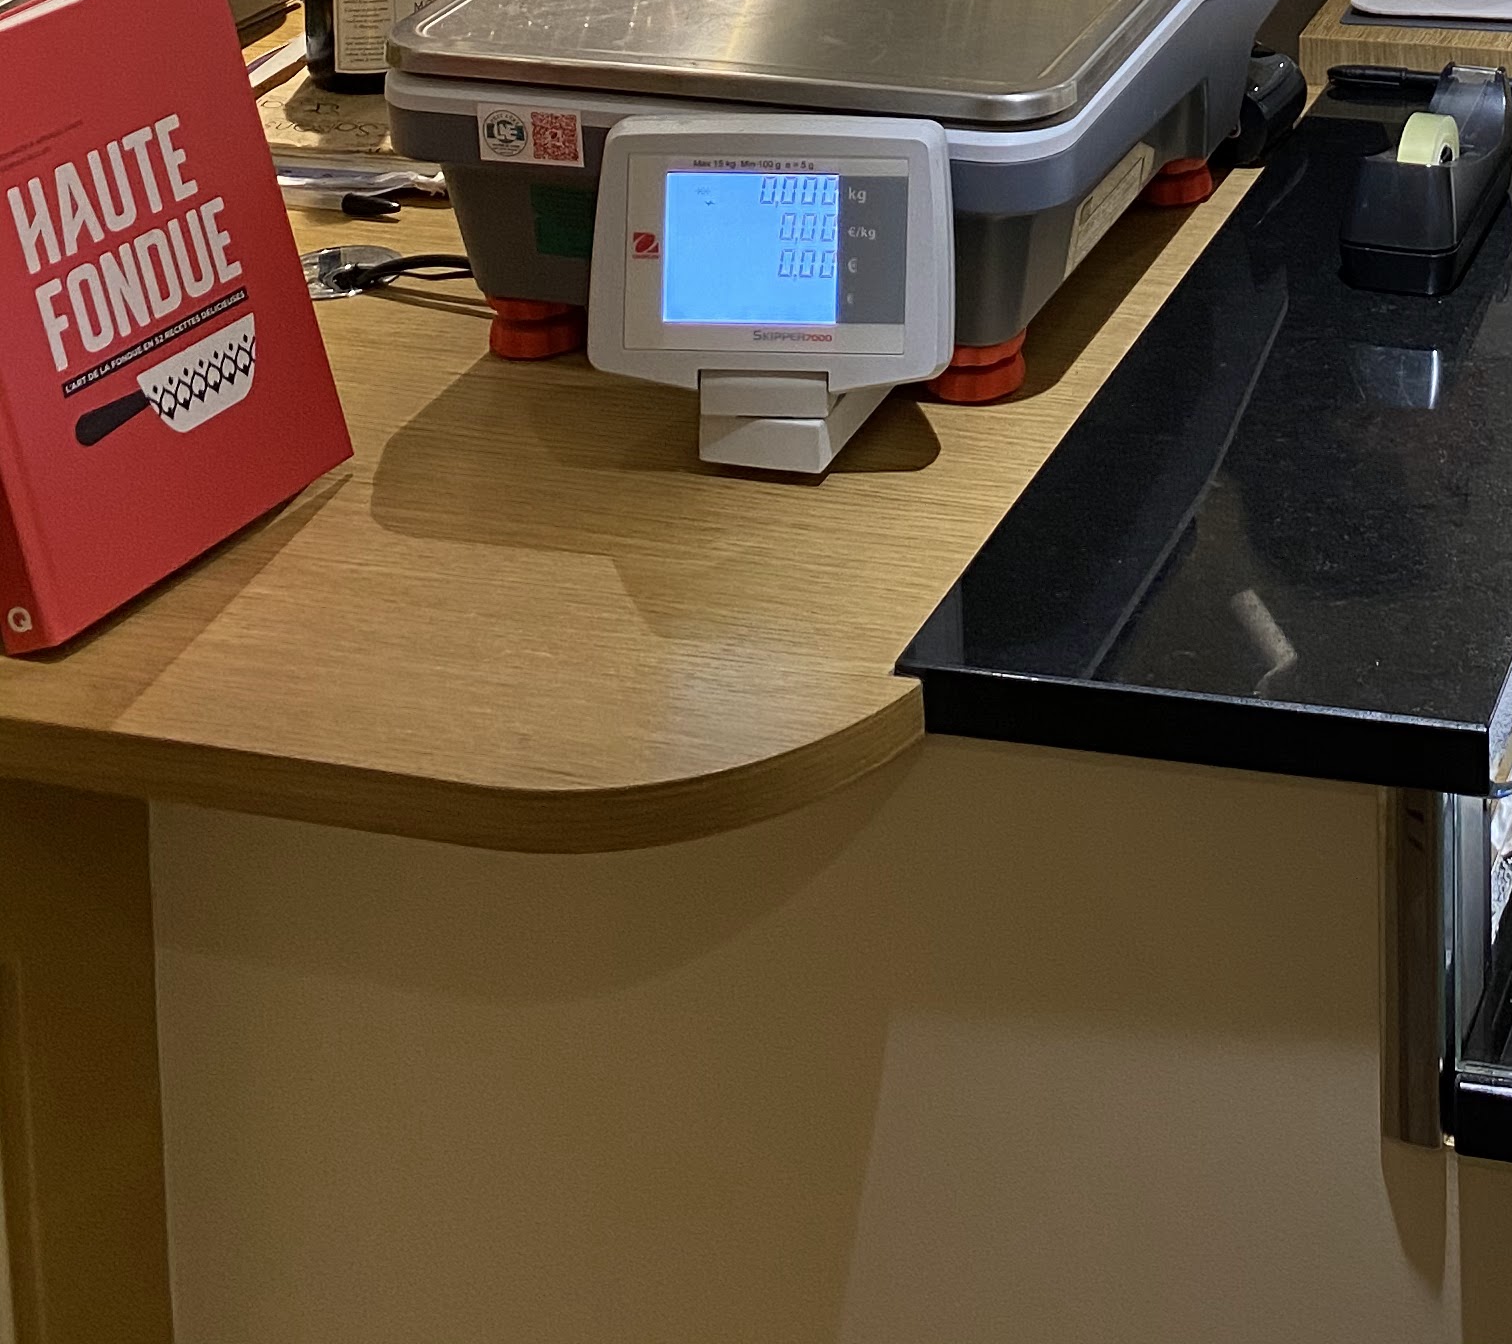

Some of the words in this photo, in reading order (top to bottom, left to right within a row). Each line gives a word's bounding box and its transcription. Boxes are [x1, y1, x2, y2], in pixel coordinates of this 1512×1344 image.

[7, 114, 198, 274] HAUTE
[848, 187, 867, 203] kg
[35, 197, 242, 372] FONDUE
[8, 607, 32, 632] Q
